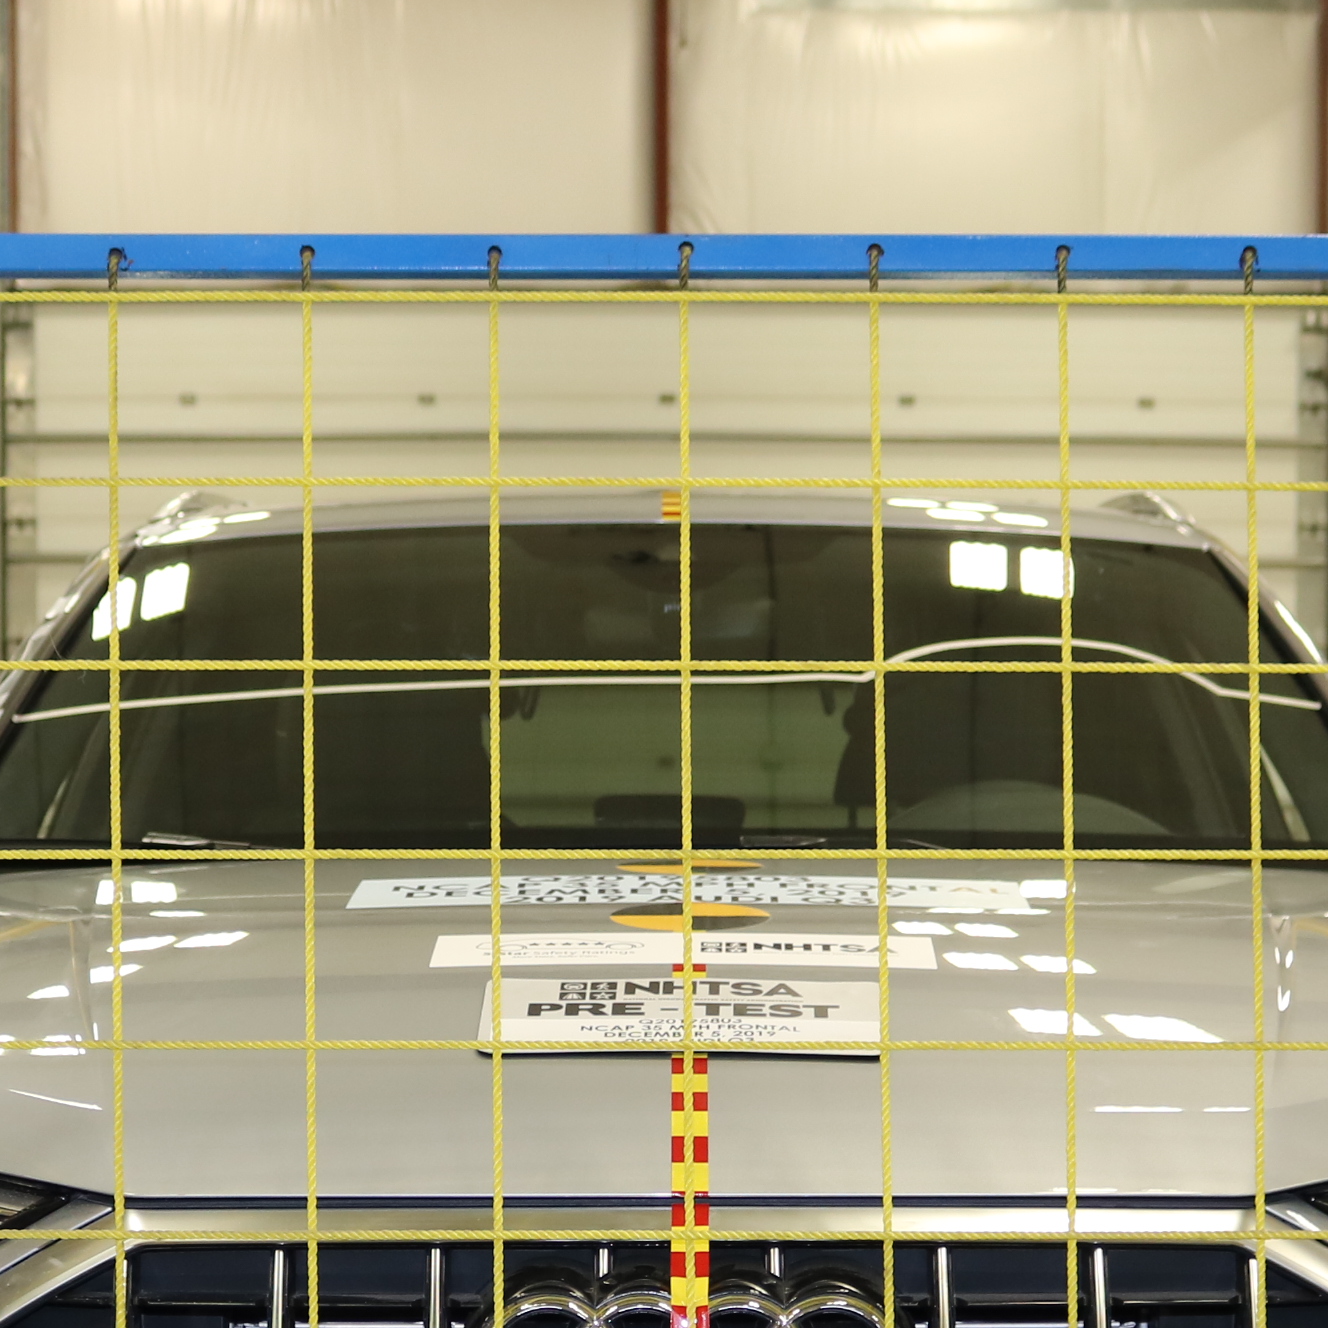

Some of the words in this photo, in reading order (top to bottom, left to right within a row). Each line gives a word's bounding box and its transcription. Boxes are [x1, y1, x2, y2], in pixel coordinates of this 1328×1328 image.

[391, 882, 542, 892] NCAP
[504, 895, 626, 904] 2019
[647, 895, 780, 904] AUDI
[801, 897, 875, 905] Q3
[753, 942, 899, 954] NHTSA
[624, 981, 804, 998] NHTSA
[527, 1002, 646, 1017] PRE
[694, 1002, 840, 1019] TEST
[717, 1023, 801, 1033] FRONTAL
